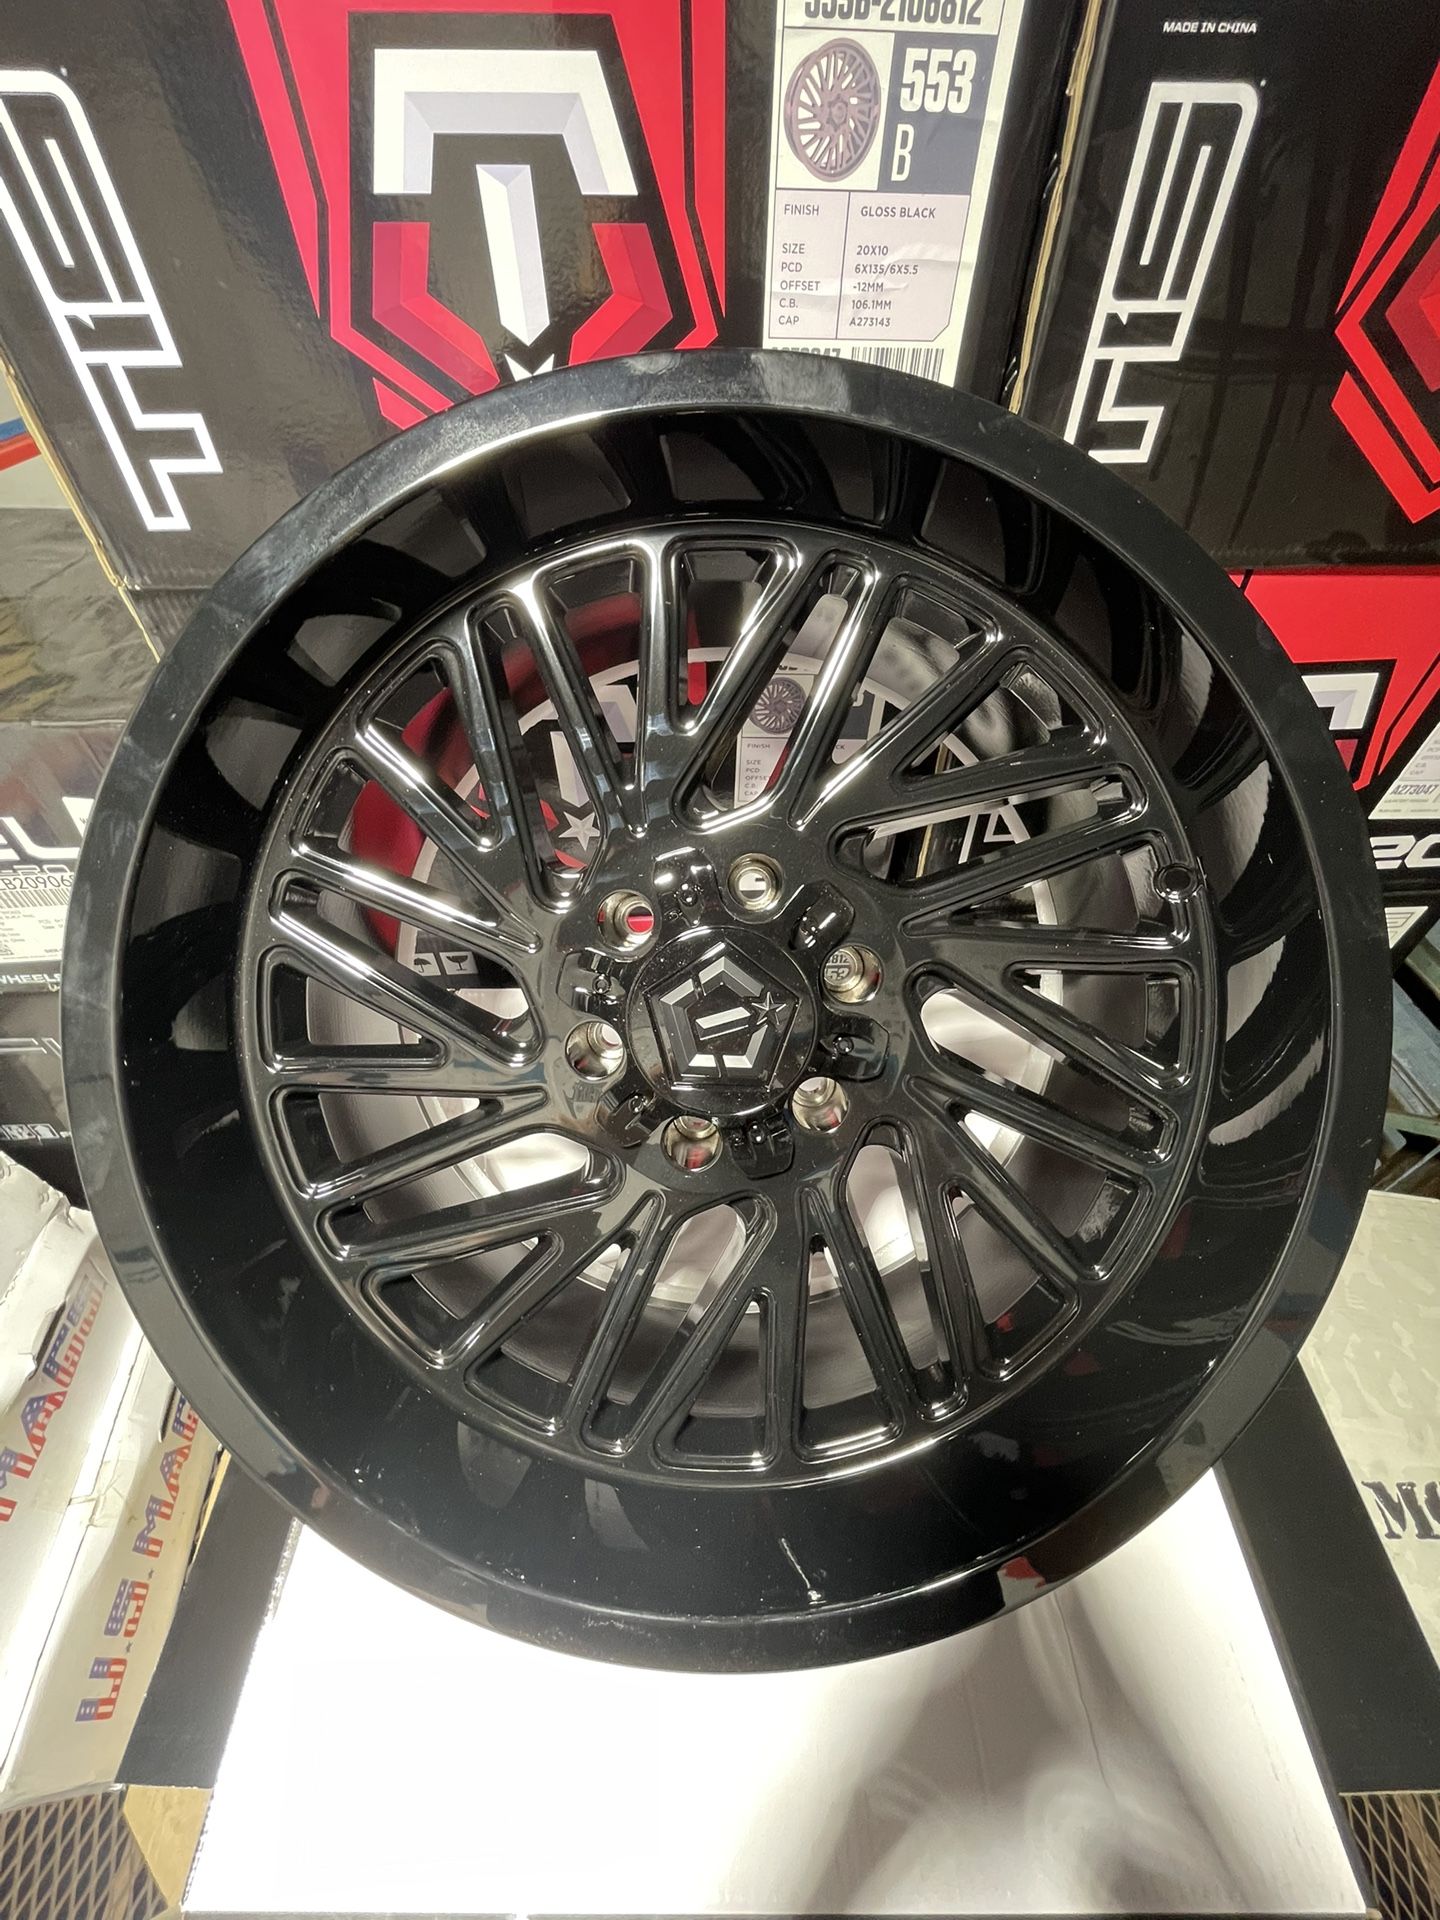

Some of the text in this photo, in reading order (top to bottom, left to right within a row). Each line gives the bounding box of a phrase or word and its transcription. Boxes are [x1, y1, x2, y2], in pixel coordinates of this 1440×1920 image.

[1162, 21, 1257, 34] MADE IN CHINA
[899, 47, 977, 113] 553
[890, 123, 915, 182] B
[784, 204, 820, 216] FINISH
[860, 206, 936, 219] GLOSS BLACK
[782, 243, 805, 254] SIZE
[856, 245, 889, 256] 20X10
[781, 262, 803, 272] PCD
[854, 264, 919, 276] 6X135/6X5.5
[780, 280, 820, 291] OFFSET
[853, 282, 884, 292] -12MM
[779, 298, 799, 308] C.B.
[851, 300, 892, 310] 106.1MM
[778, 316, 800, 325] CAP
[849, 317, 891, 327] A273143
